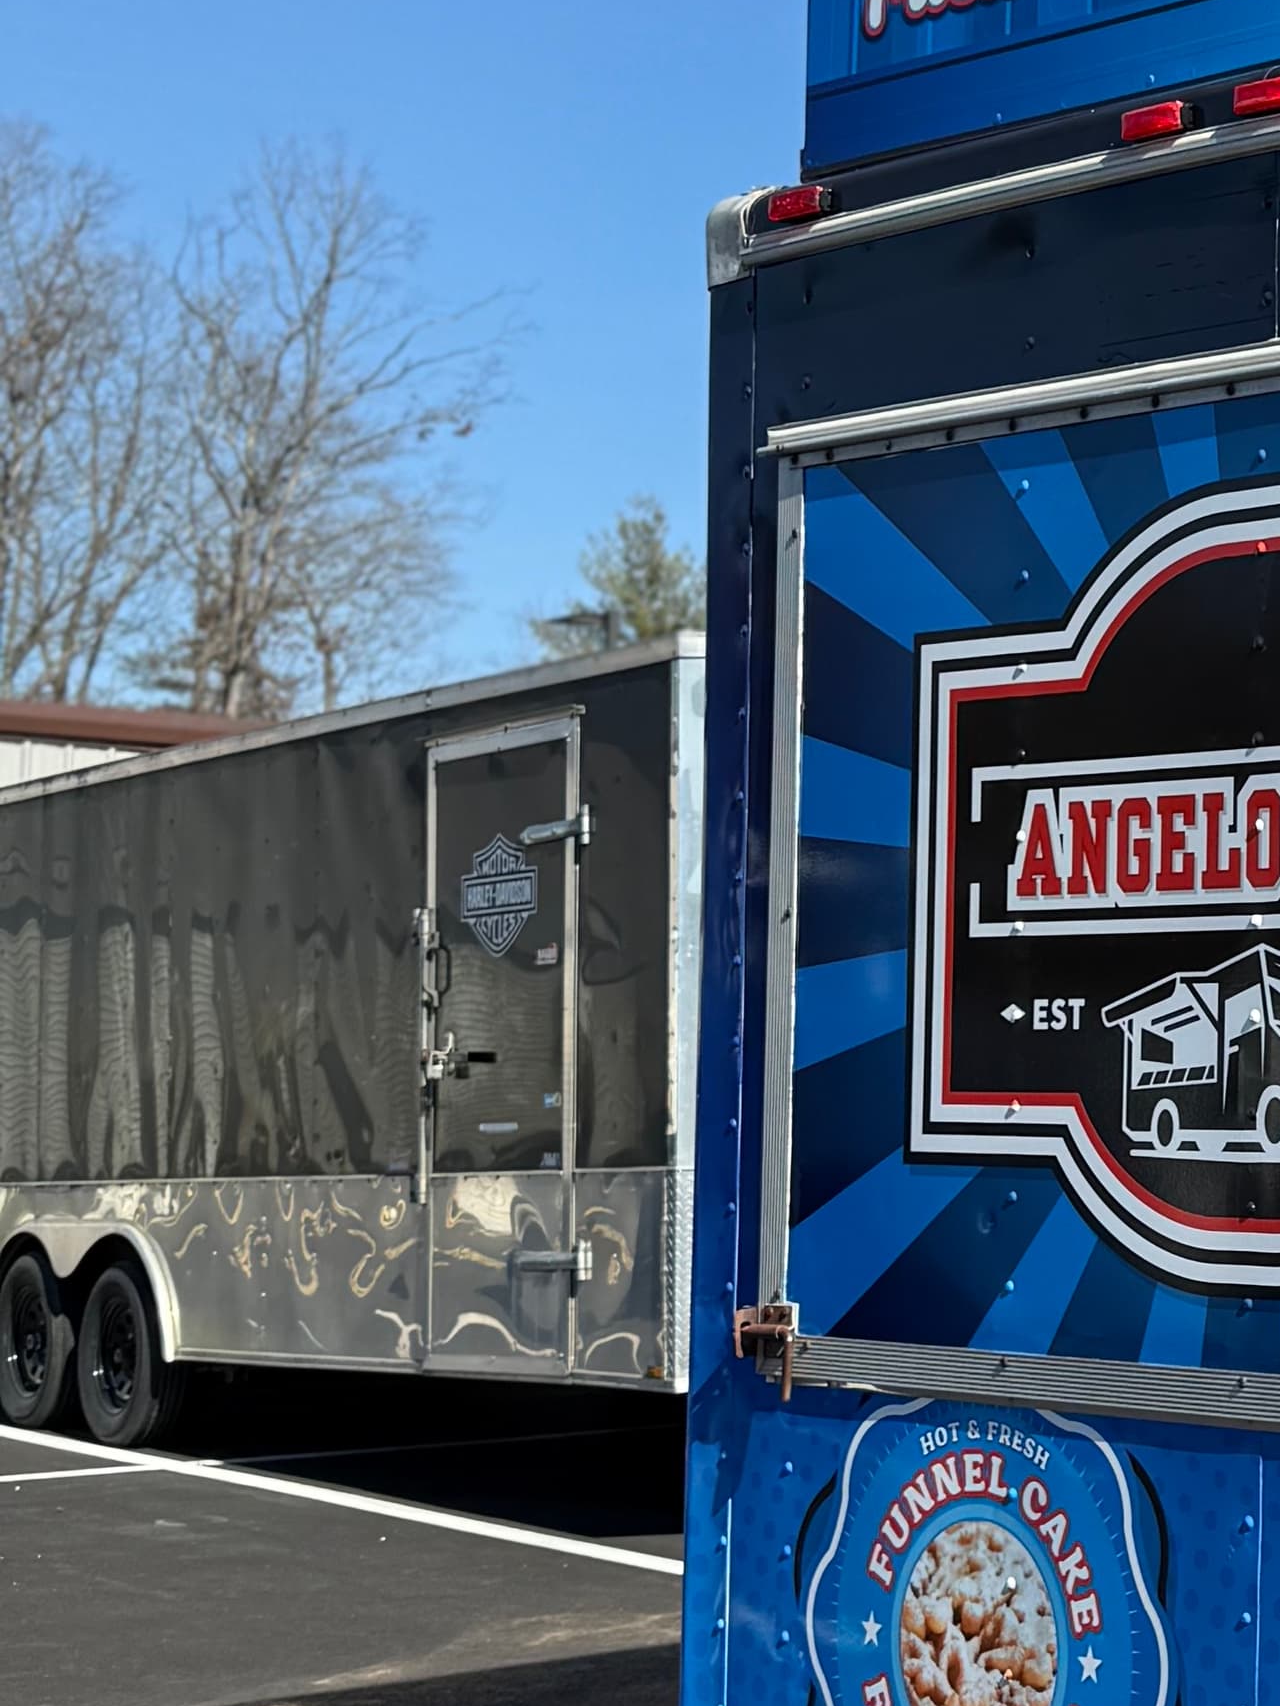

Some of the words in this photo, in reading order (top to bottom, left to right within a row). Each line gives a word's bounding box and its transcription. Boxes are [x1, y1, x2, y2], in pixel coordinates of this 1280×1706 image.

[1032, 998, 1085, 1032] EST
[920, 1423, 961, 1456] HOT
[966, 1419, 982, 1440] &
[986, 1421, 1051, 1471] FRESH
[867, 1449, 1011, 1592] FUNNEL
[1018, 1475, 1102, 1639] CAKE
